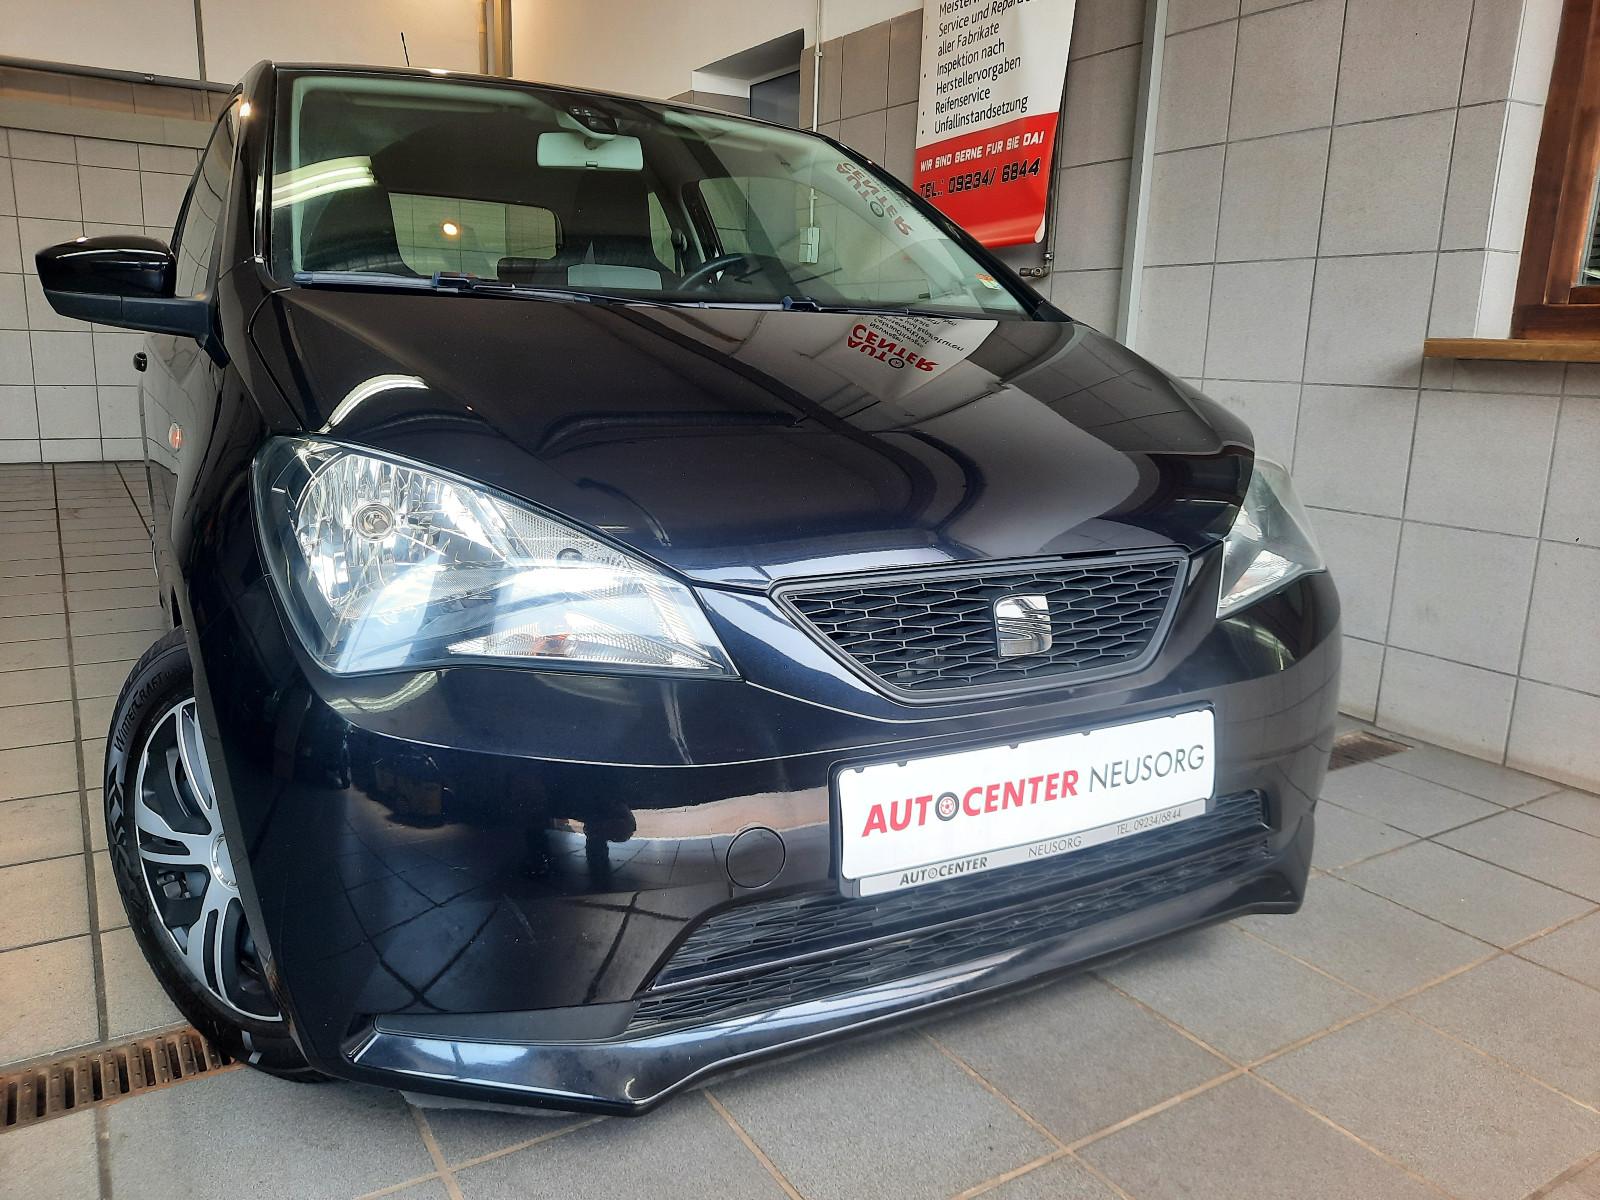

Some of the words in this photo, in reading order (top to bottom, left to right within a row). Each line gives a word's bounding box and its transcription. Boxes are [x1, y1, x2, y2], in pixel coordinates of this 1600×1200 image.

[938, 16, 970, 37] Service
[972, 3, 990, 24] und
[938, 38, 955, 57] aller
[956, 22, 1000, 48] Fabrikate
[936, 49, 979, 78] Inspektion
[982, 38, 1005, 58] nach
[936, 56, 1021, 96] Herstellervorgaben
[934, 95, 1028, 134] Unfallinstandsetzung
[935, 87, 991, 115] Reifenservice
[920, 160, 933, 172] WIR
[934, 153, 952, 168] SIND
[954, 147, 983, 164] GERNE
[1006, 136, 1020, 150] SIE
[948, 168, 997, 194] 09234/
[1001, 157, 1041, 184] 6844
[1088, 744, 1205, 793] NEUSORG
[1028, 835, 1082, 858] NEUSORG
